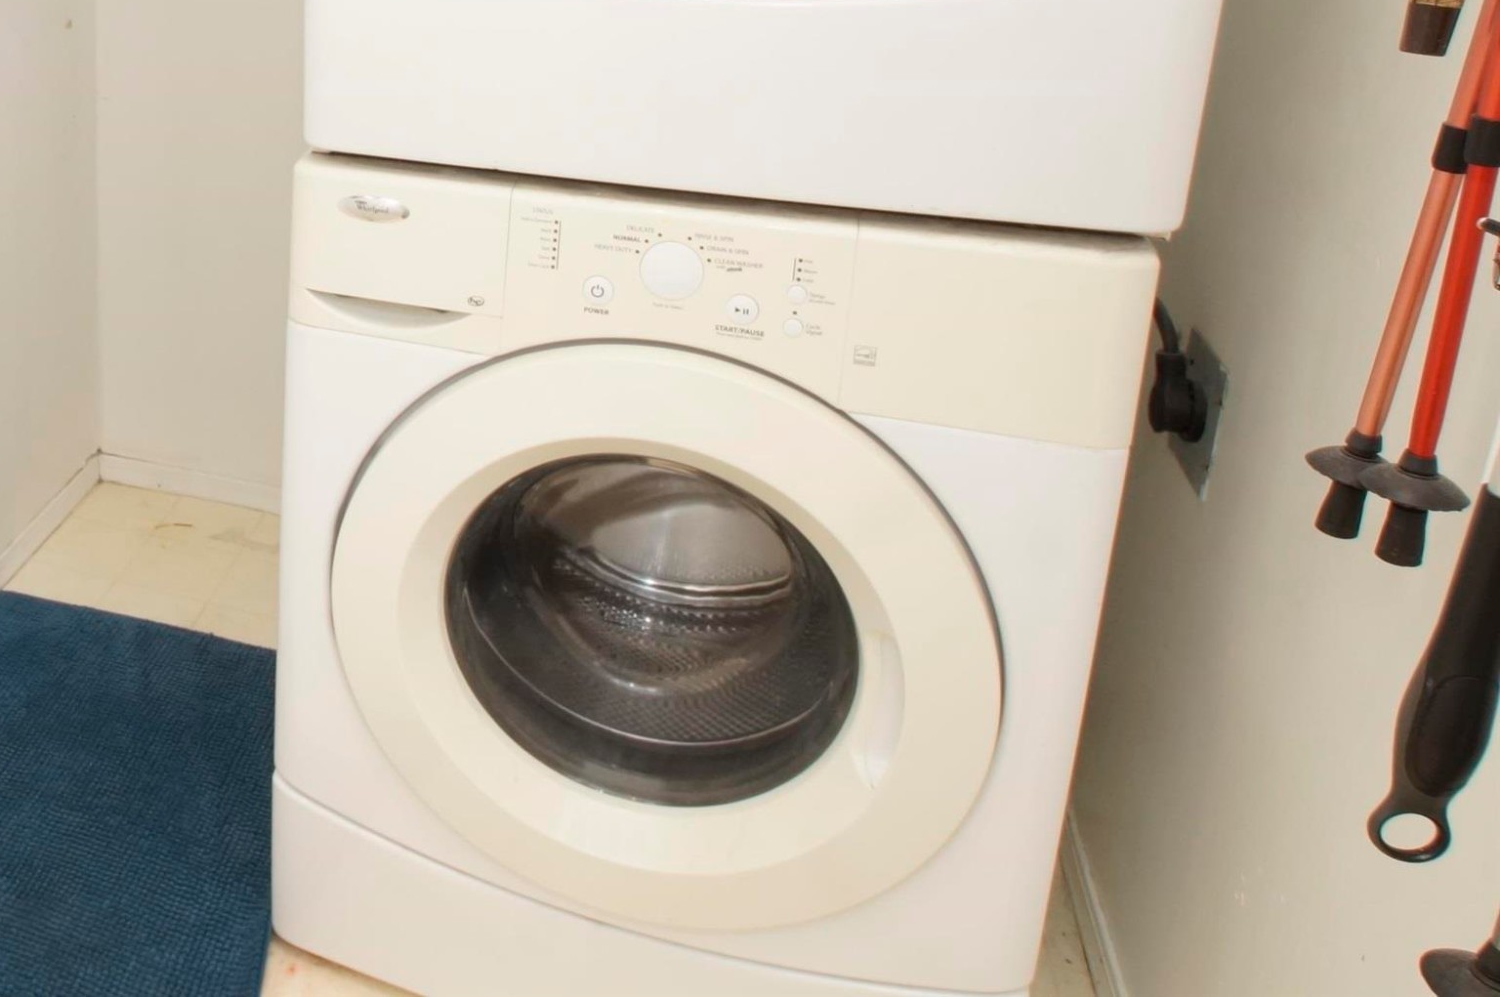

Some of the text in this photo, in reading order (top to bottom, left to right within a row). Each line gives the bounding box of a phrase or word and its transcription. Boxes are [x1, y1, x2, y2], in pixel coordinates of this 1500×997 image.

[354, 200, 389, 215] Whirlpool
[613, 234, 641, 244] NORMAL
[736, 259, 763, 269] WASHER
[583, 306, 610, 316] POWER
[714, 325, 765, 337] START/PAUSE
